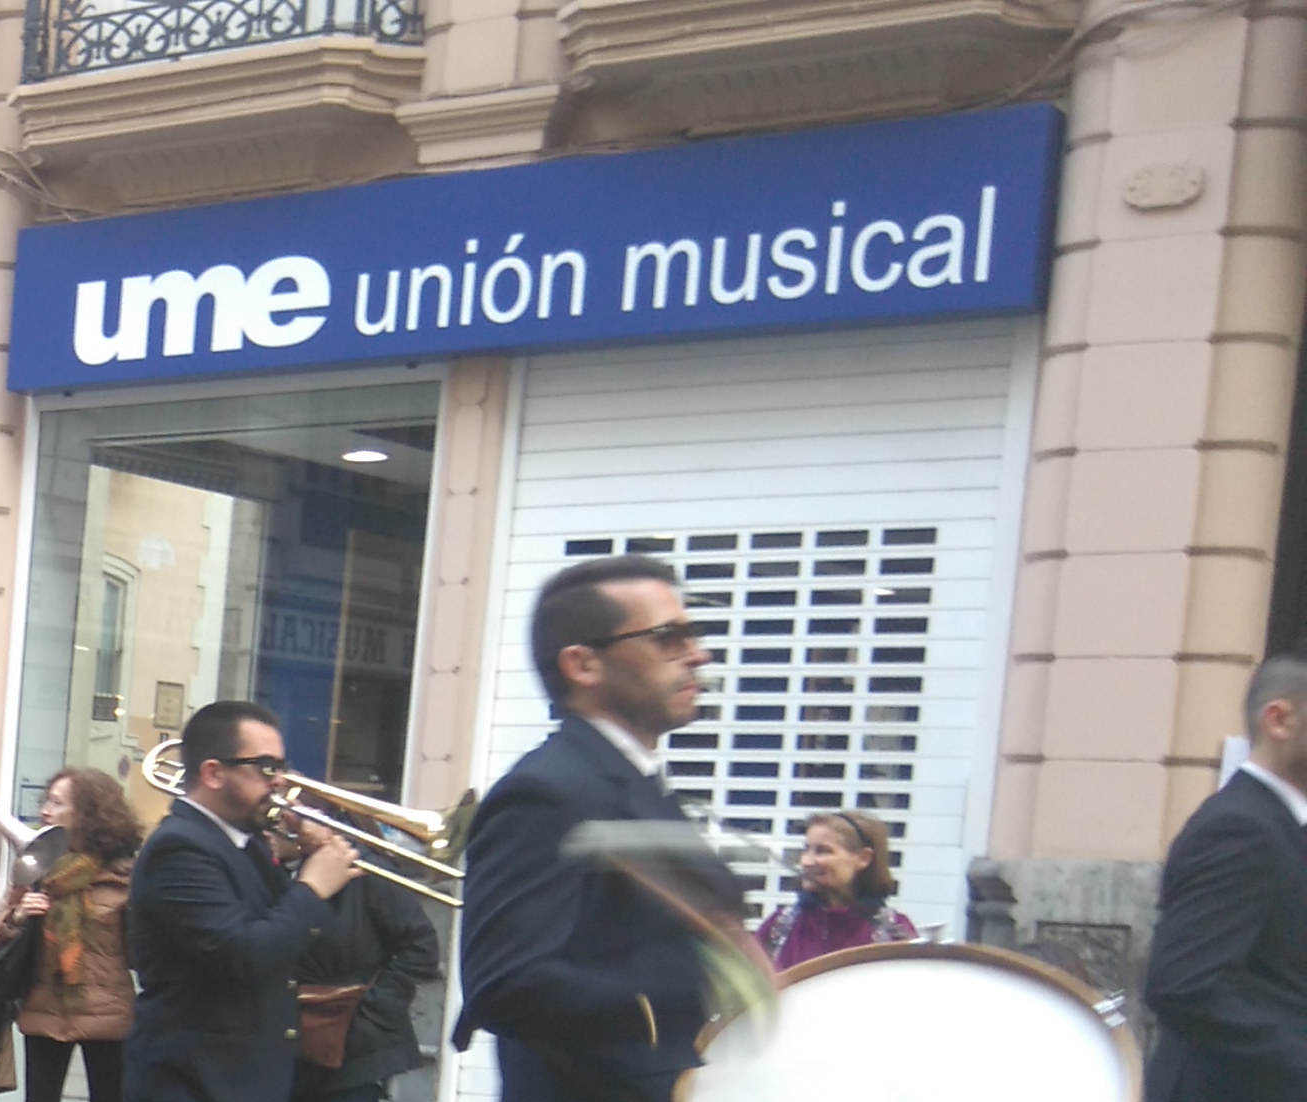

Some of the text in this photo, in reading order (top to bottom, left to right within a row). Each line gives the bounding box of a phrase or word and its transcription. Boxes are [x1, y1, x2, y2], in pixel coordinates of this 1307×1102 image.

[72, 185, 997, 367] ume unión musical
